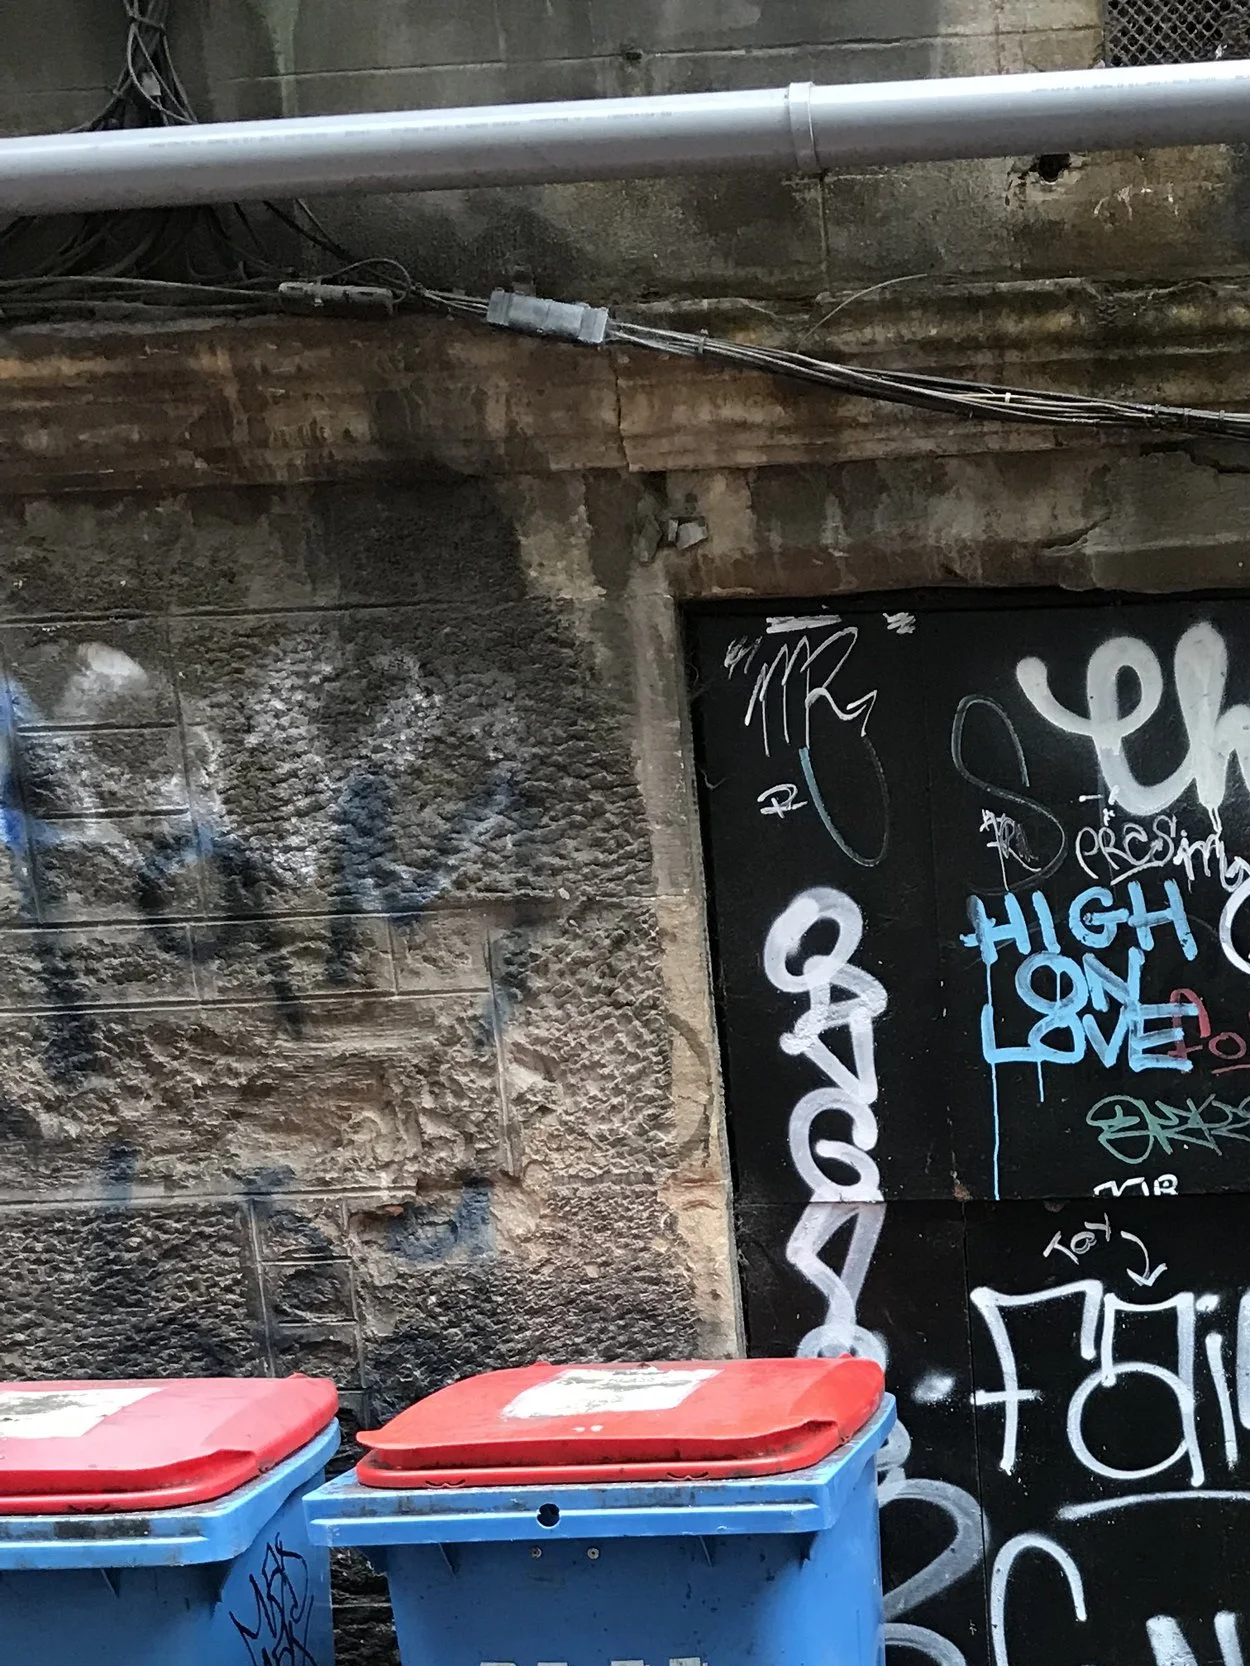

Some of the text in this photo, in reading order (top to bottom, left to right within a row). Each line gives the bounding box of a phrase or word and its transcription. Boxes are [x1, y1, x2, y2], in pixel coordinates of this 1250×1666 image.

[959, 878, 1198, 961] HIGH
[1015, 946, 1146, 1015] ON
[980, 1002, 1200, 1073] LOVE
